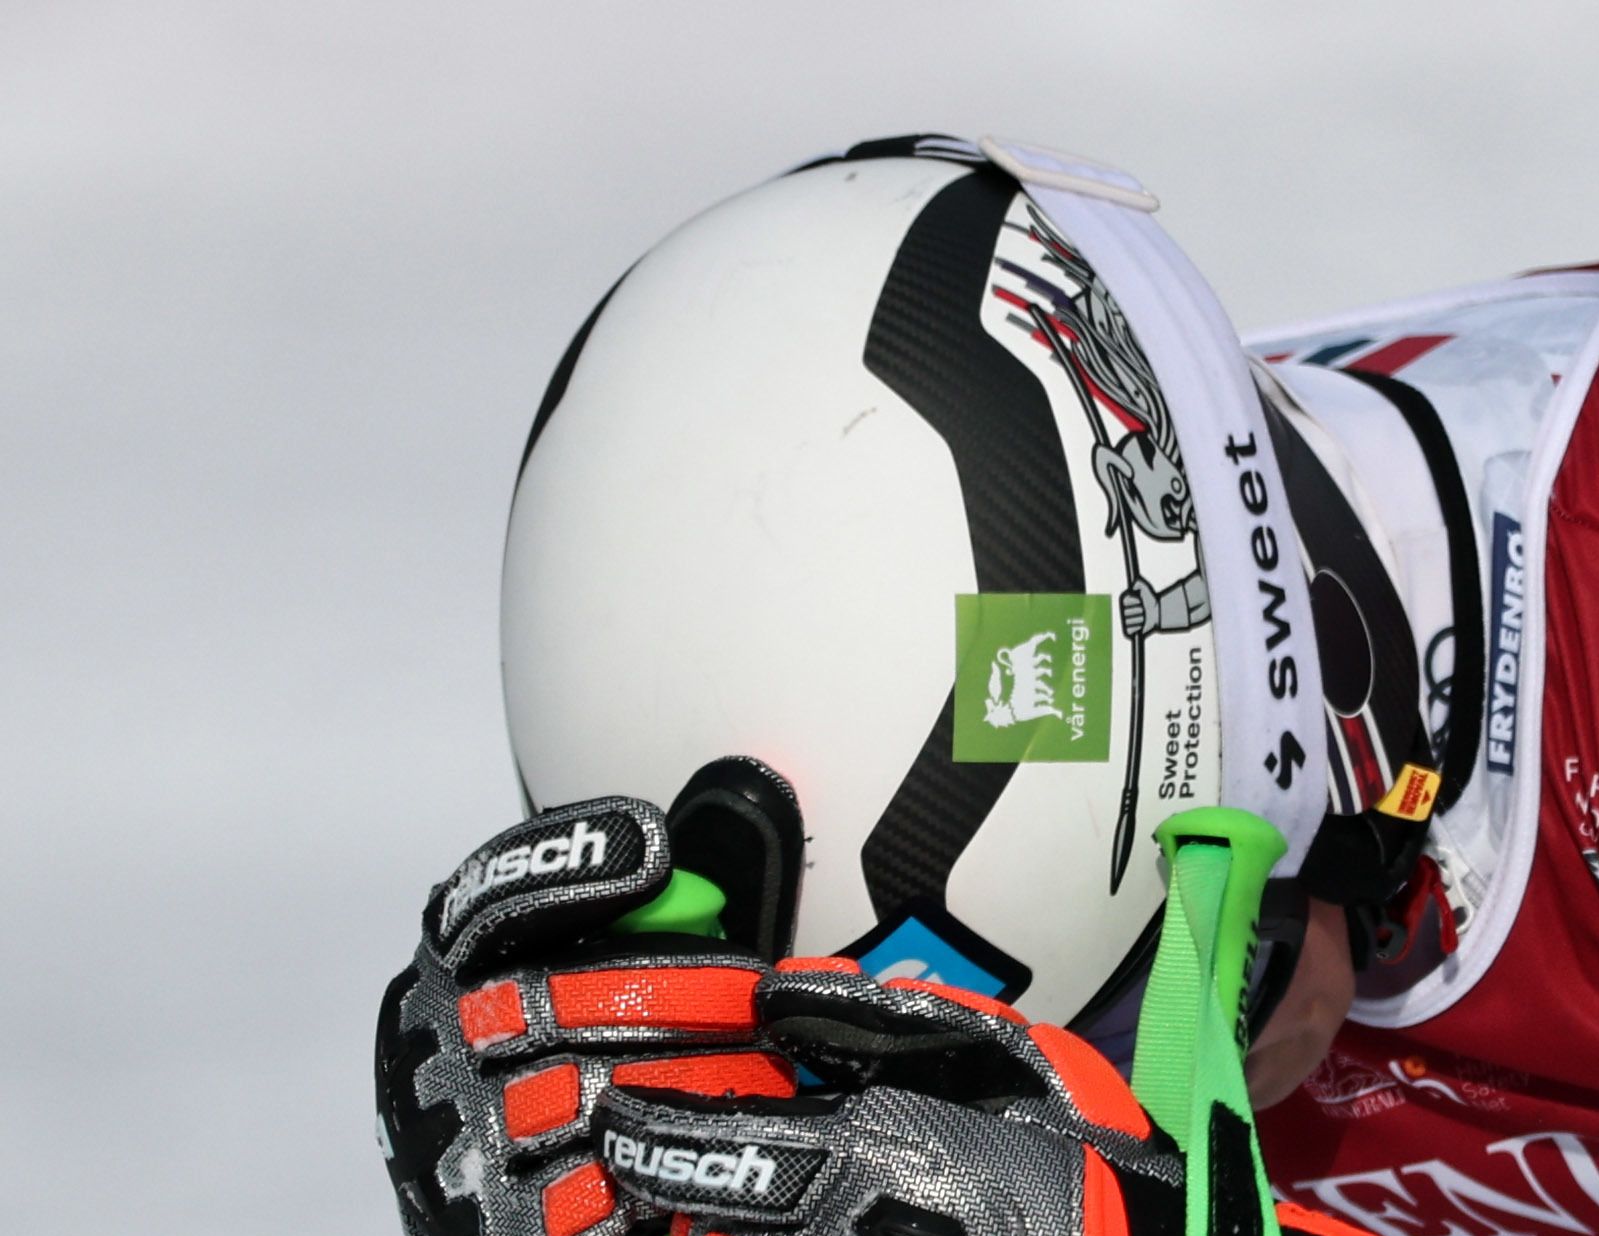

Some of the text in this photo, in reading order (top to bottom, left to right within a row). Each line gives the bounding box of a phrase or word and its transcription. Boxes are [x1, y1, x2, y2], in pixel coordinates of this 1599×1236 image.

[1225, 432, 1298, 700] sweet
[1067, 618, 1090, 741] vår energi
[1179, 647, 1203, 799] Protection
[1158, 709, 1181, 800] Sweet
[603, 1129, 777, 1193] reusch
